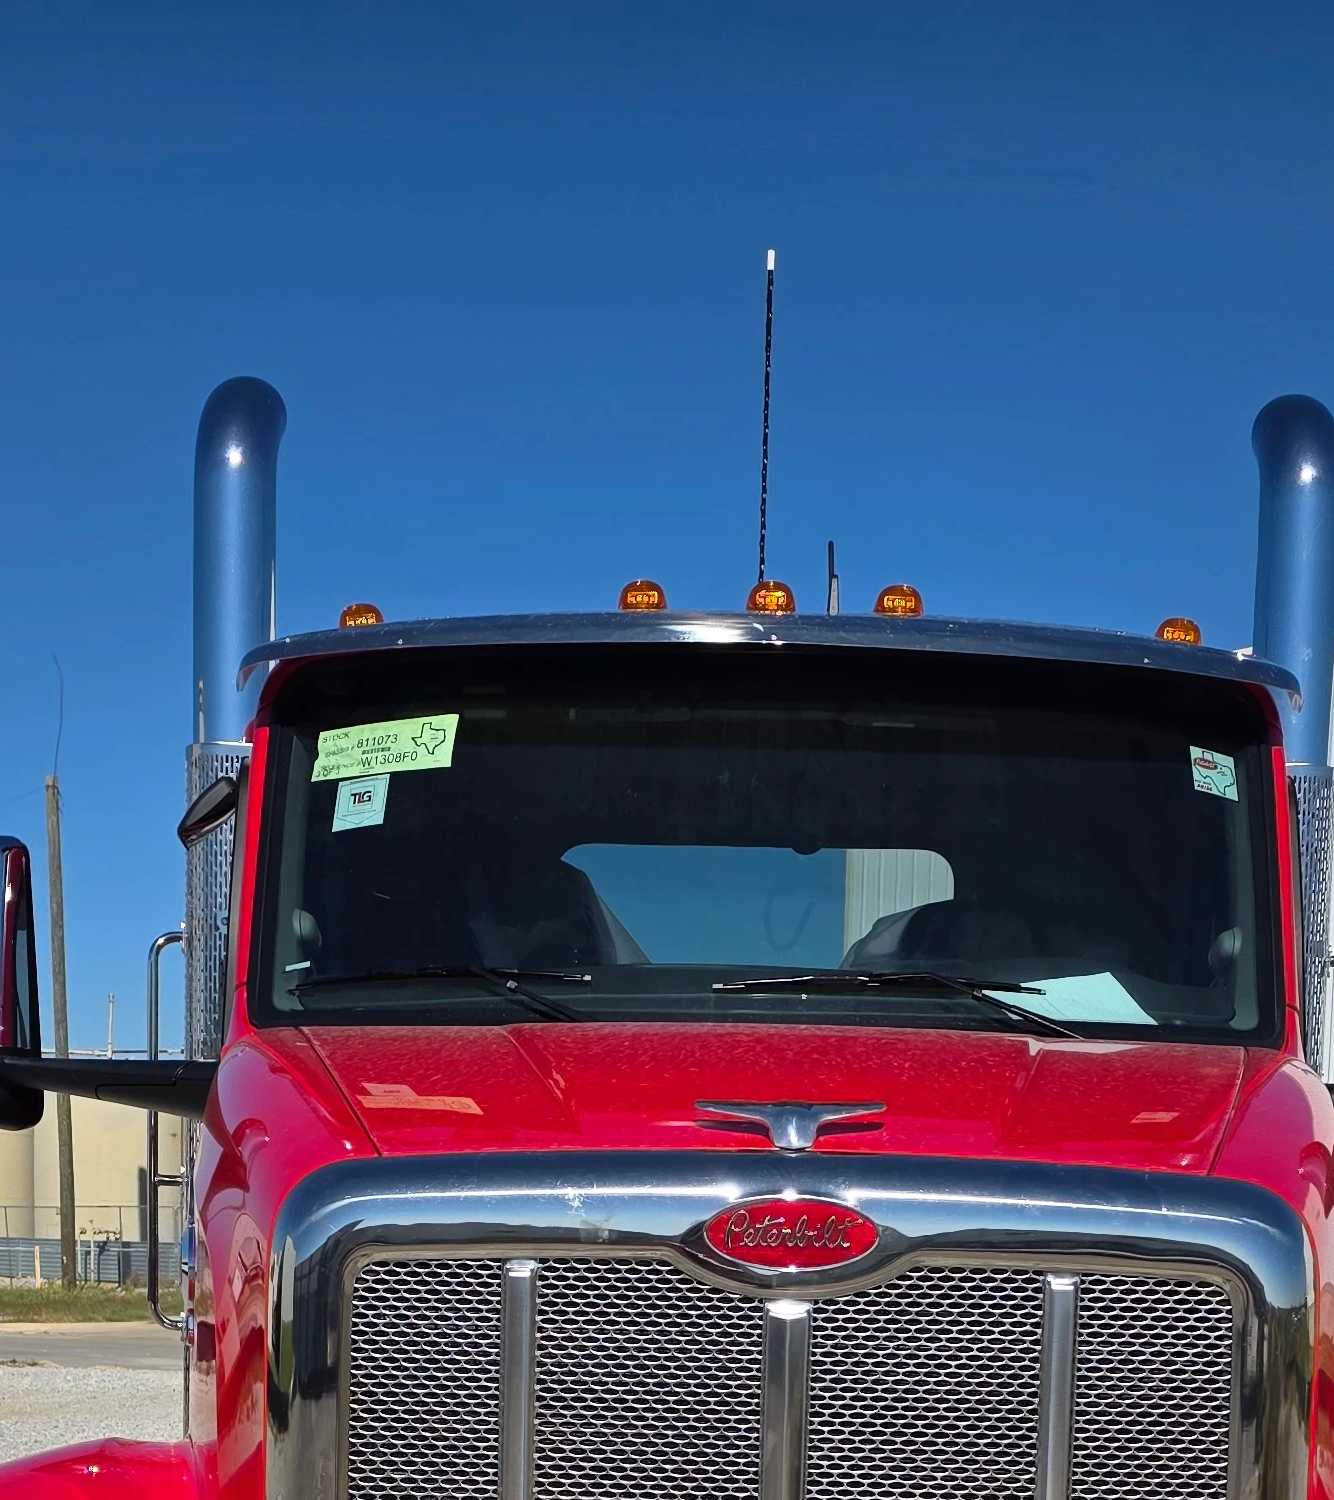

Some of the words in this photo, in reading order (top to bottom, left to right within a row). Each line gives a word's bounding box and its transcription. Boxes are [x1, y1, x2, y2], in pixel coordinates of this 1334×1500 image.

[356, 734, 398, 748] 811073
[360, 751, 418, 768] W1308F0
[350, 790, 372, 805] TLG
[724, 1209, 864, 1248] Peterbilt
